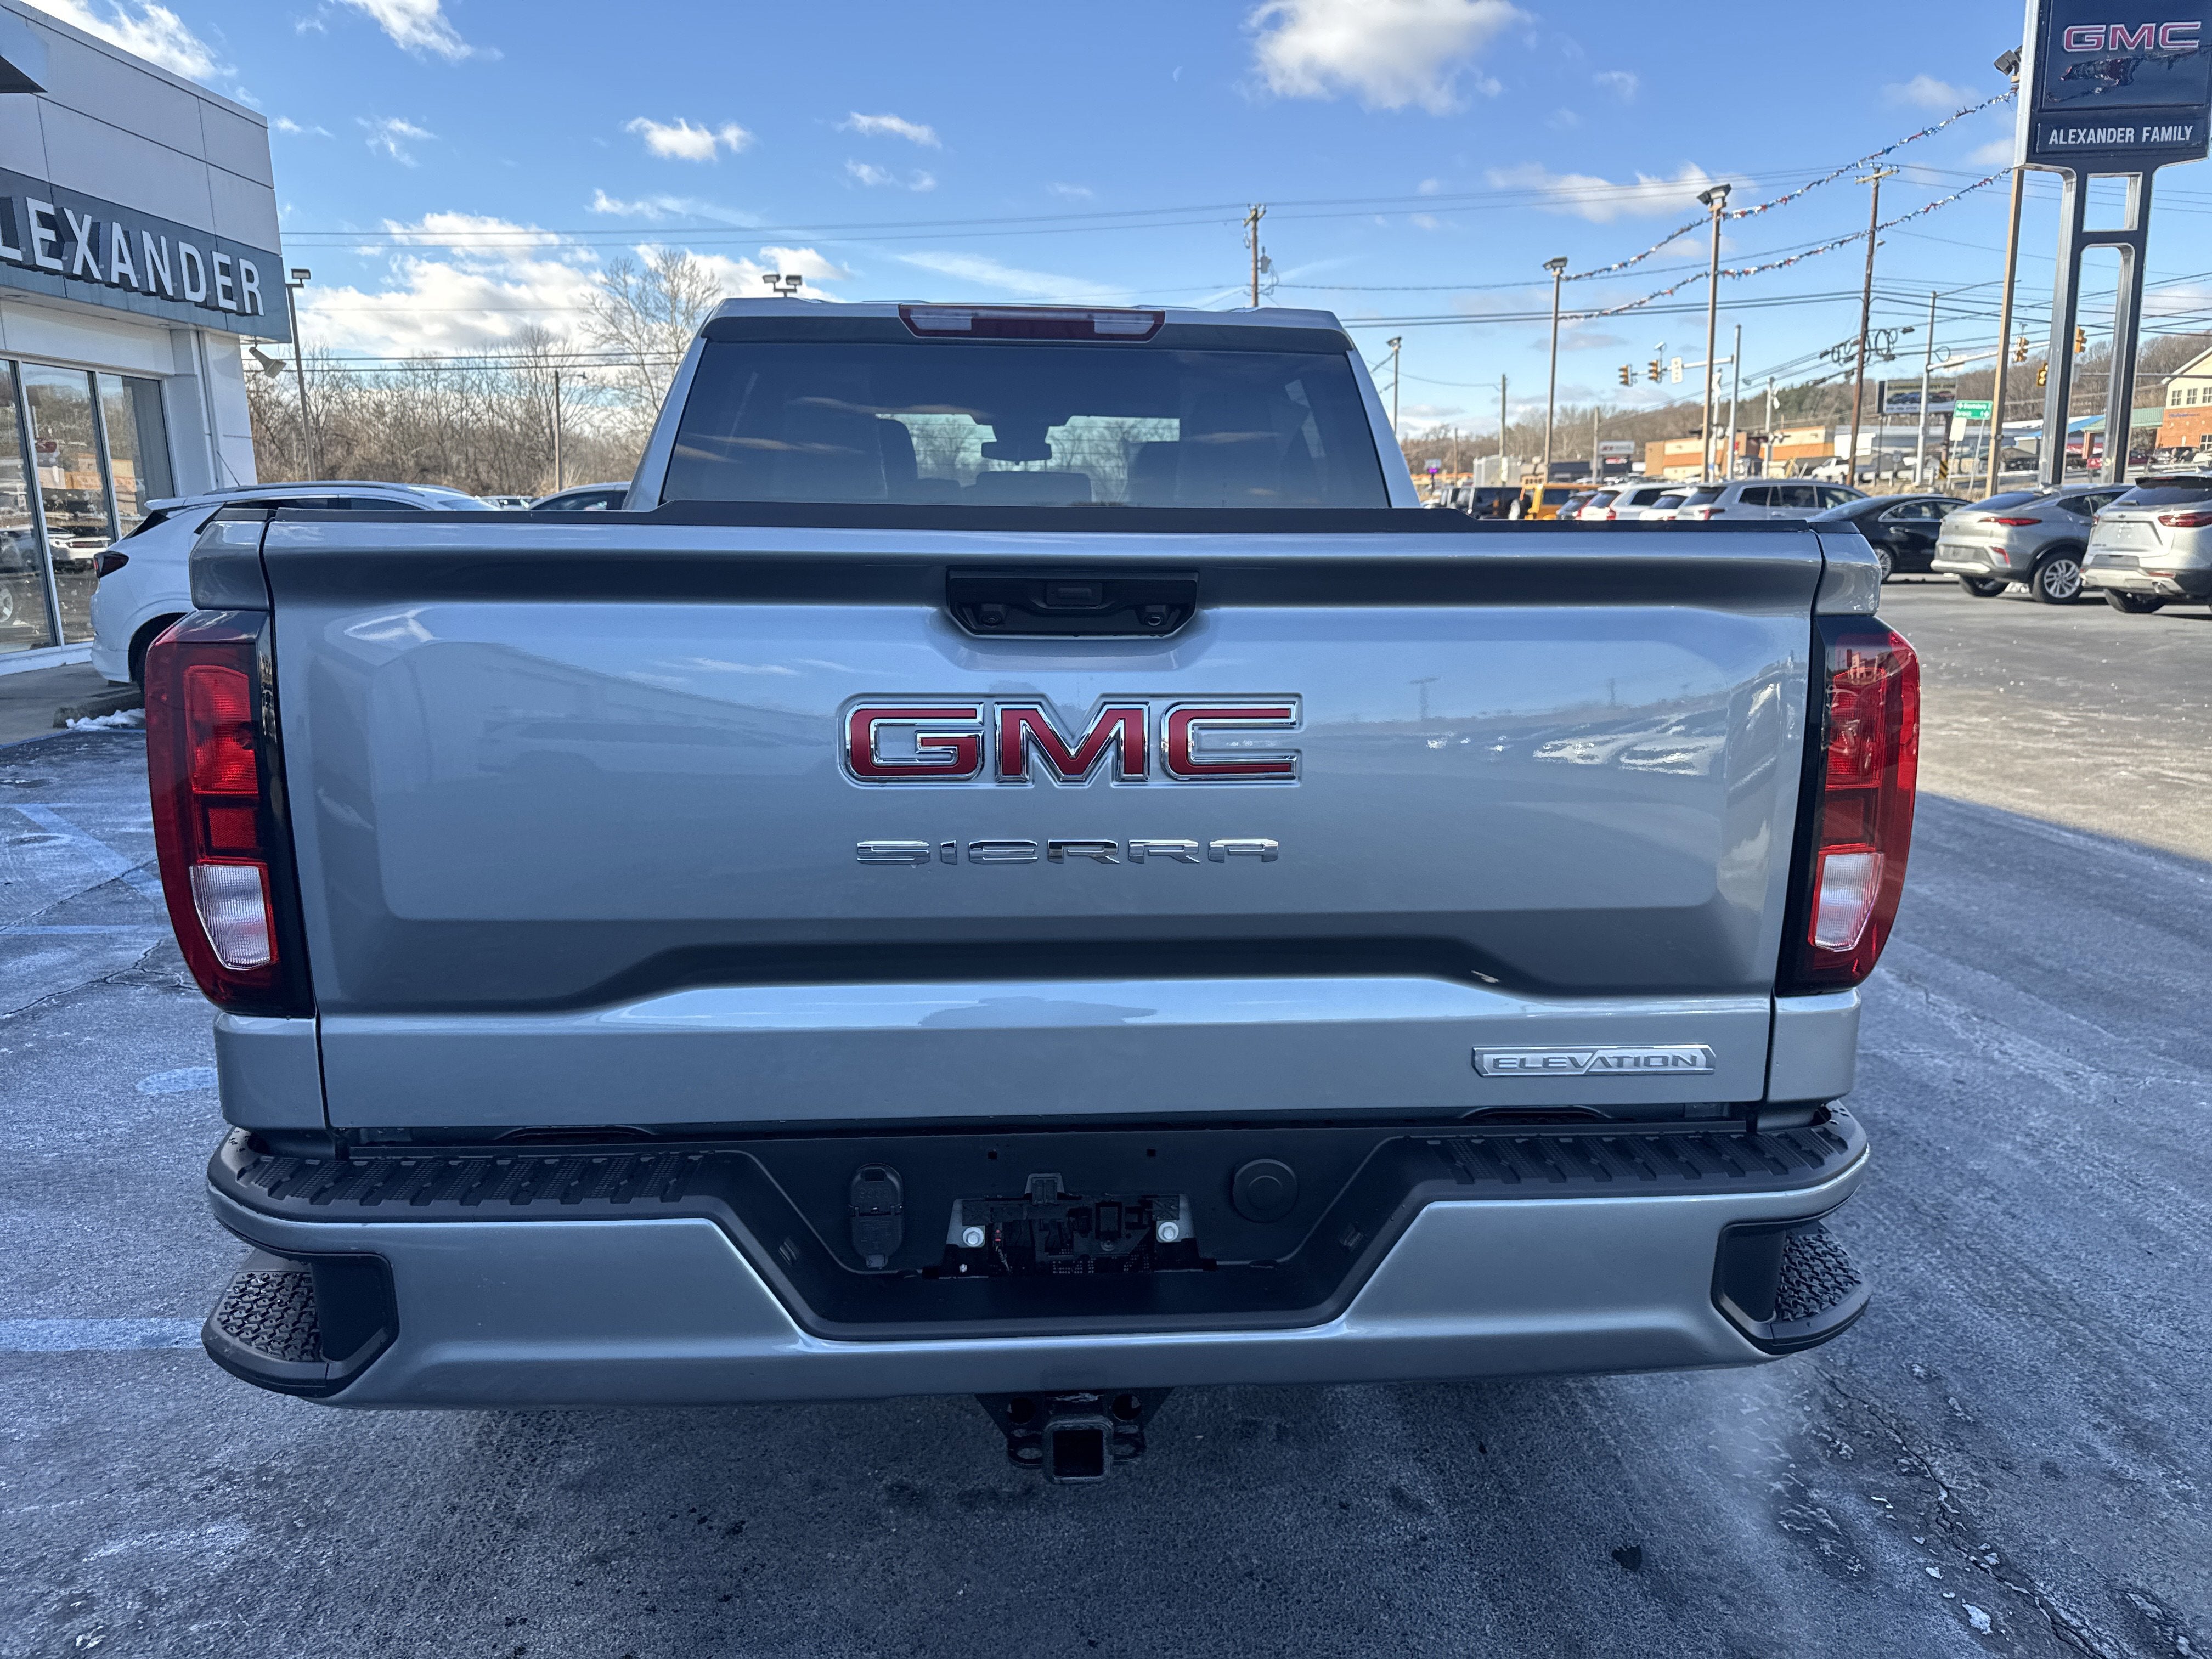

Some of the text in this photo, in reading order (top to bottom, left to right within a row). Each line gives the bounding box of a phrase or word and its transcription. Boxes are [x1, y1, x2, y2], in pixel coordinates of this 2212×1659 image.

[2064, 21, 2201, 52] GMC
[2049, 125, 2193, 145] ALEXANDER FAMILY
[844, 701, 1298, 783] GMC
[857, 839, 1279, 865] SIERRA
[1493, 1054, 1698, 1070] ELEVATION
